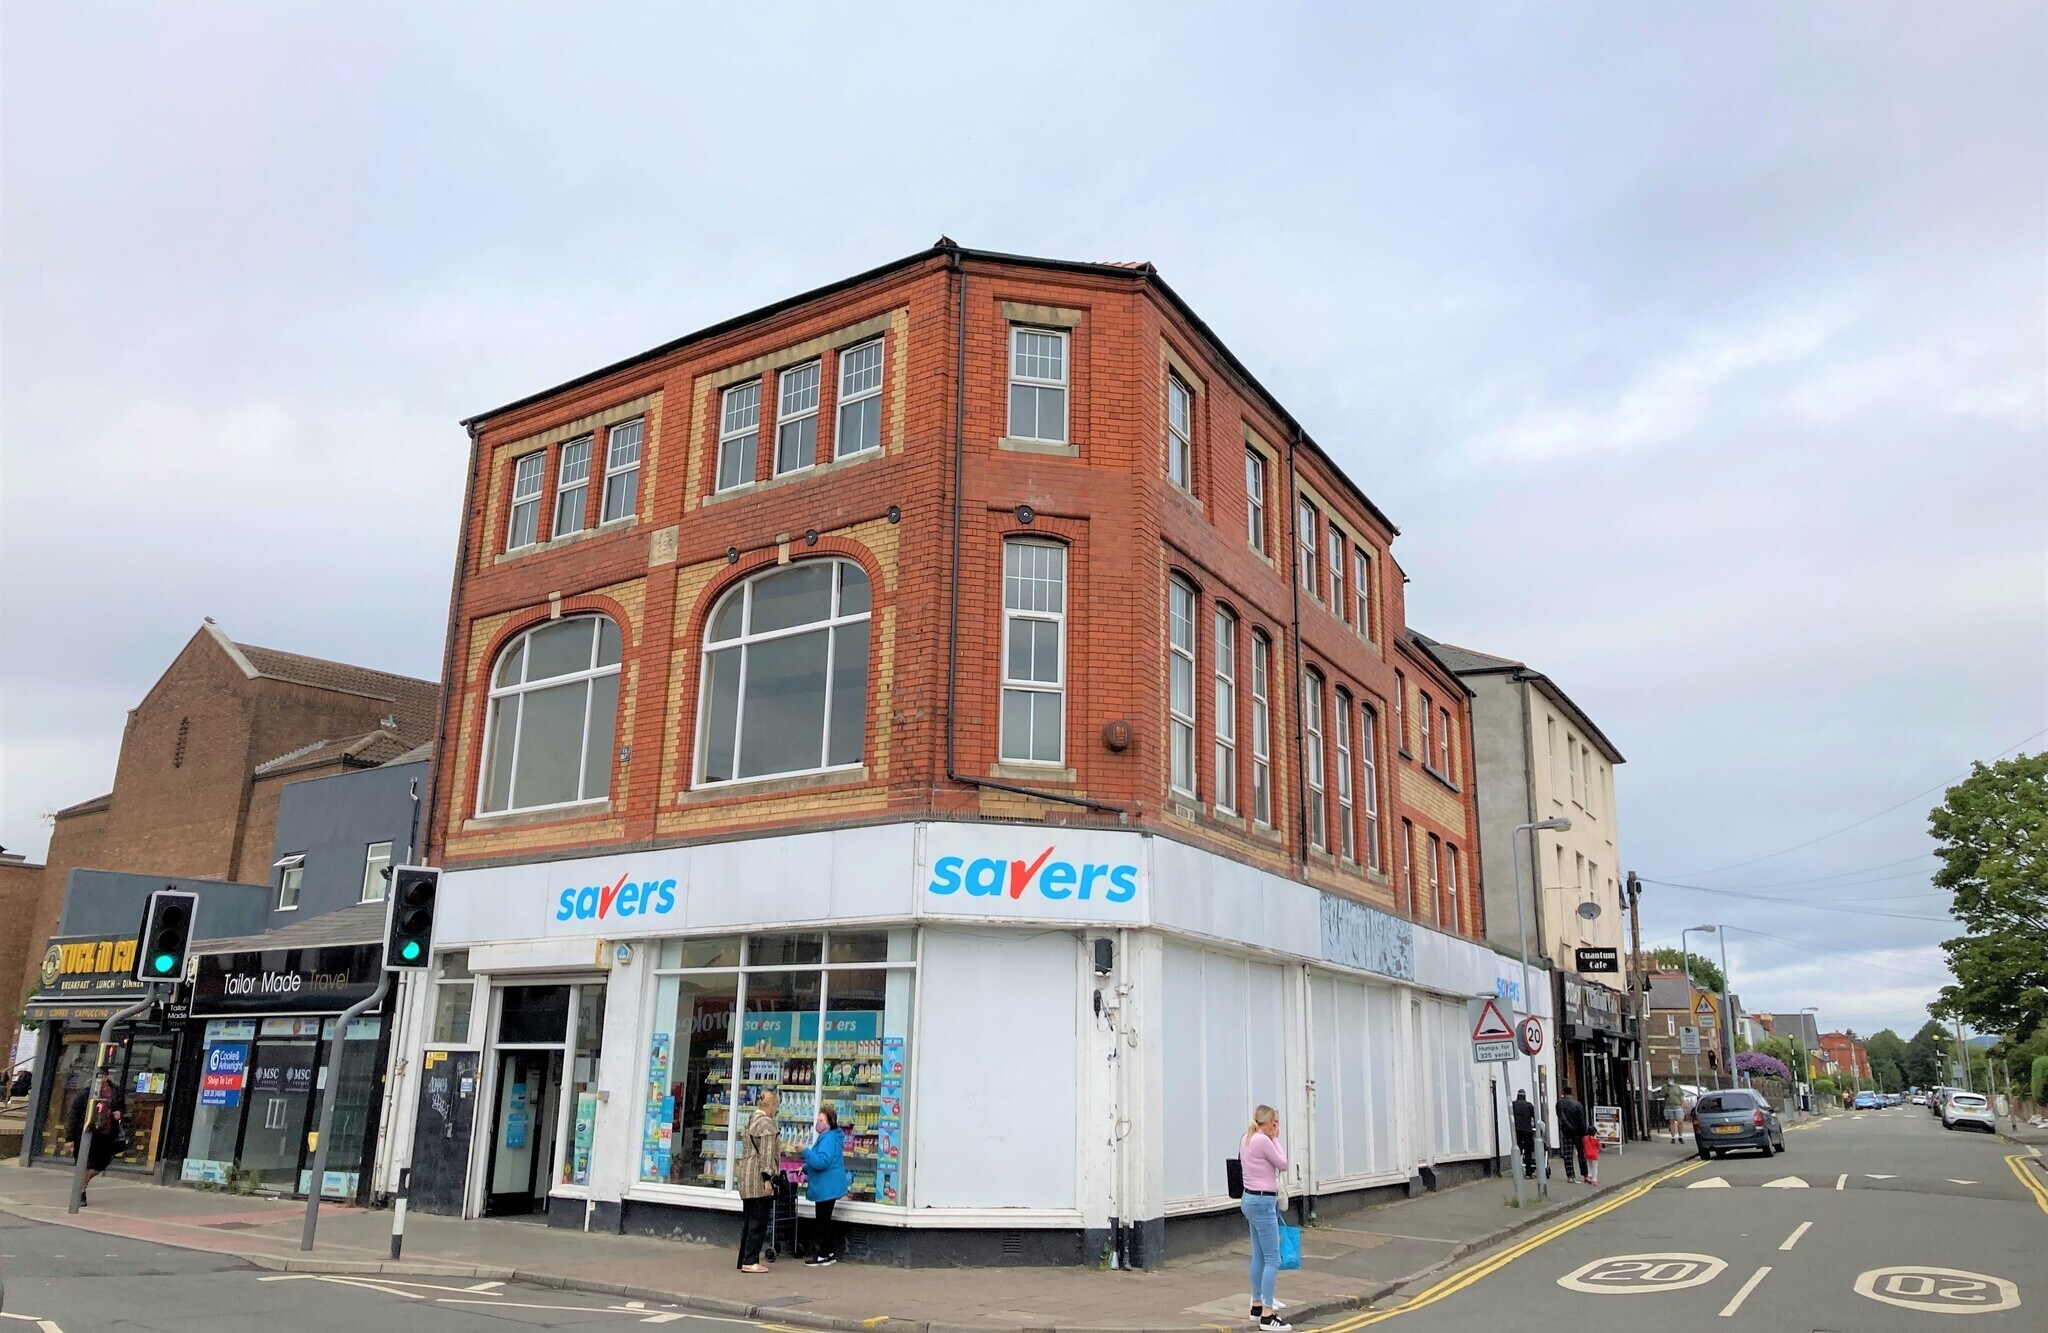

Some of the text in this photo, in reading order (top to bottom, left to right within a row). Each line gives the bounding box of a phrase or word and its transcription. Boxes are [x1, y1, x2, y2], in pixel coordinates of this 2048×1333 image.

[929, 844, 1138, 903] savers
[556, 872, 677, 921] savers
[59, 943, 96, 974] TUCK
[1580, 951, 1616, 960] Quantum
[1589, 961, 1608, 969] Cafe
[61, 980, 91, 990] BREAKFAST
[96, 979, 116, 989] LUNCH
[224, 968, 350, 995] Tailor Made Travel
[49, 1008, 69, 1018] COFFEE
[744, 1016, 781, 1031] savers
[824, 1017, 857, 1032] avers
[1527, 1027, 1541, 1044] 20
[207, 1075, 233, 1086] Shop To Let
[263, 1068, 280, 1079] MSC
[294, 1069, 311, 1080] MSC
[1589, 1262, 1700, 1281] 20
[1885, 1275, 1988, 1300] 20
